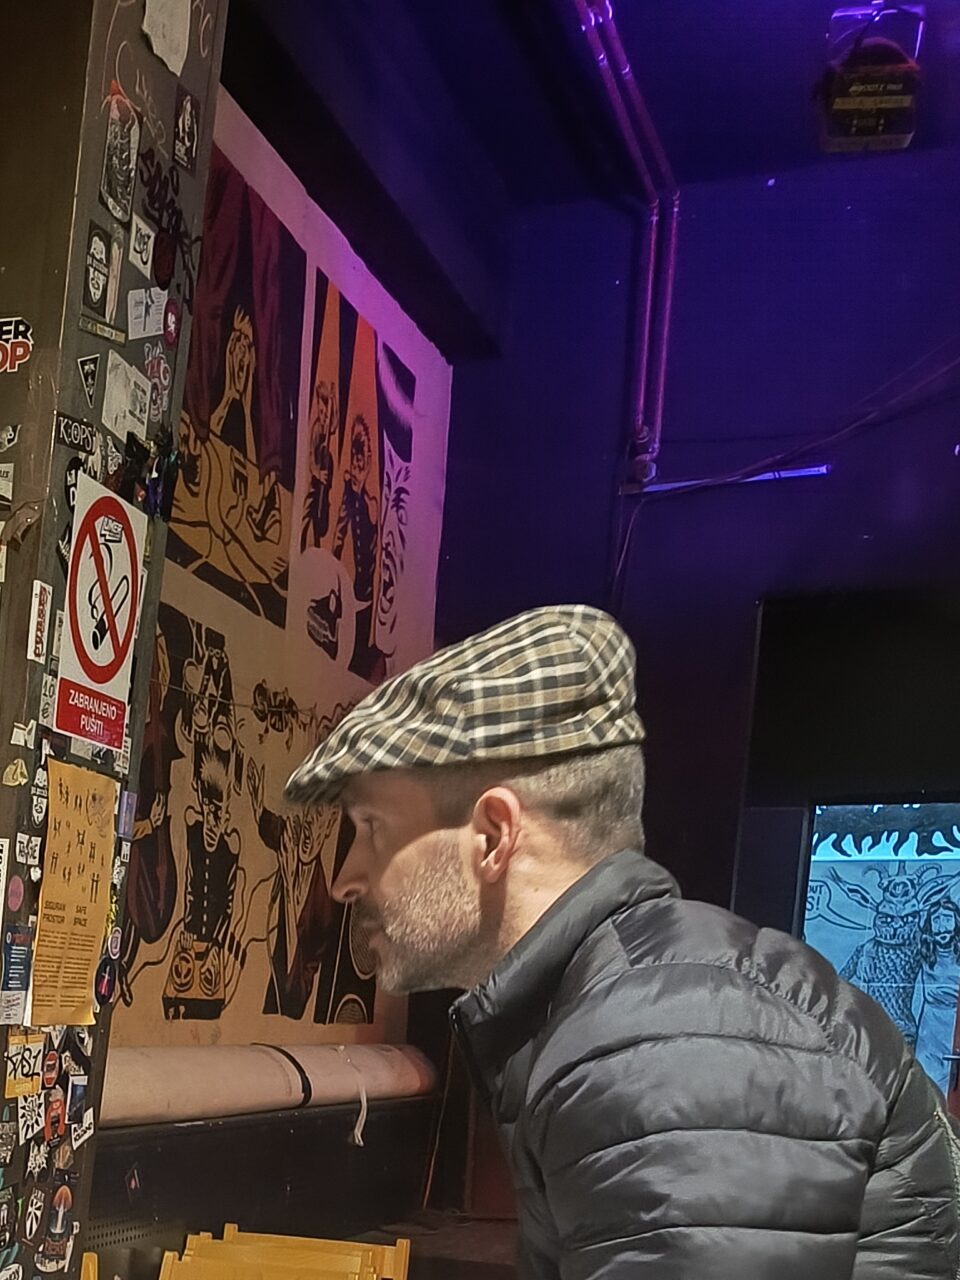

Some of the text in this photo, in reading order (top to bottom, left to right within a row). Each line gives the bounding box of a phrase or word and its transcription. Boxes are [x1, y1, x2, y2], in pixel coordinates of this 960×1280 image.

[68, 689, 118, 720] ZABRANJENO
[80, 713, 104, 736] PUŠITI
[75, 904, 87, 915] SAFE
